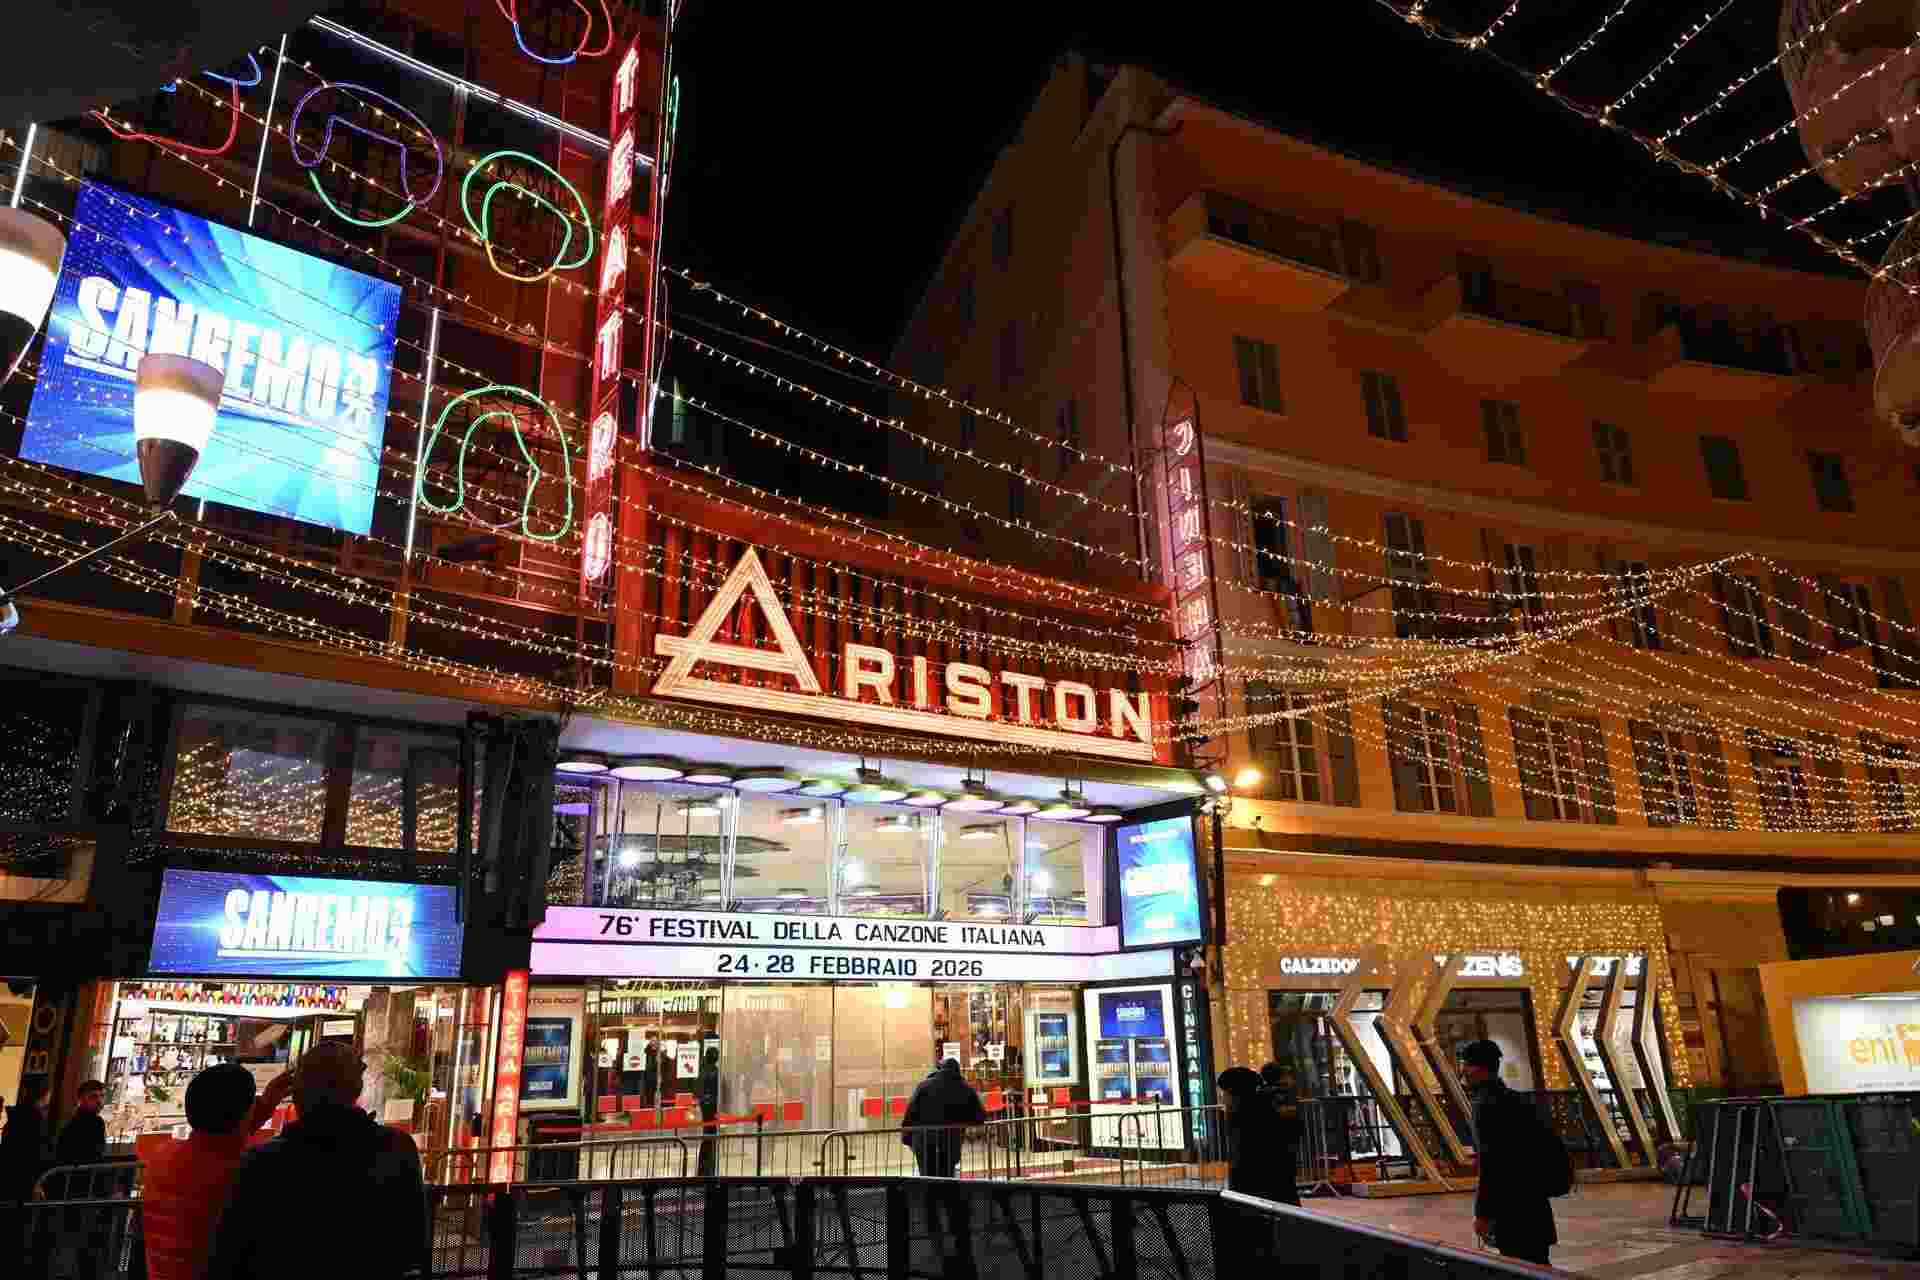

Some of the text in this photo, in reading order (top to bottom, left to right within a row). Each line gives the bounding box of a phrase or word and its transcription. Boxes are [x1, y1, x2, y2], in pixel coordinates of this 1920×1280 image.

[652, 545, 1153, 744] ARISTON
[649, 917, 760, 940] FESTIVAL
[773, 921, 842, 941] DELLA
[855, 923, 948, 944] CANZONE
[961, 927, 1046, 946] ITALIANA
[810, 955, 917, 976] FEBBRAIO
[931, 959, 983, 977] 2026
[502, 977, 524, 1073] CINEMA
[1181, 983, 1200, 1073] CINEMA
